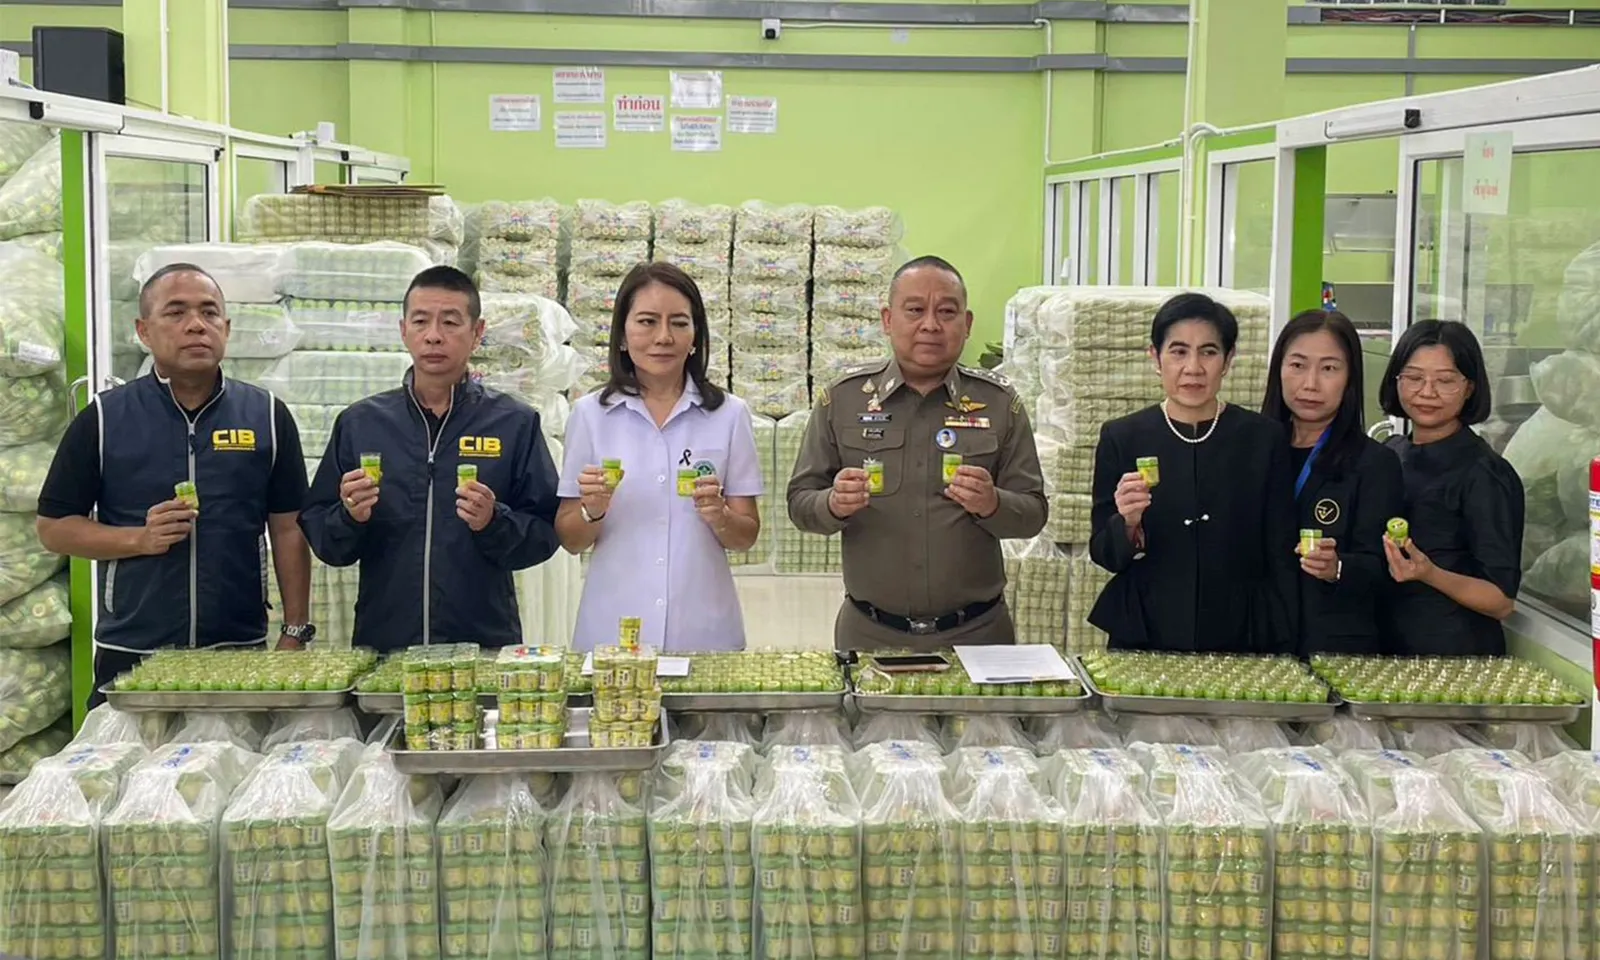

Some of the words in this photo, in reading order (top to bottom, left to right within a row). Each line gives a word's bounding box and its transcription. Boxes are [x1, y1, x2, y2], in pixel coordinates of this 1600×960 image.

[617, 95, 660, 110] ทำก่อน
[212, 428, 256, 445] CIB
[458, 435, 501, 452] CIB
